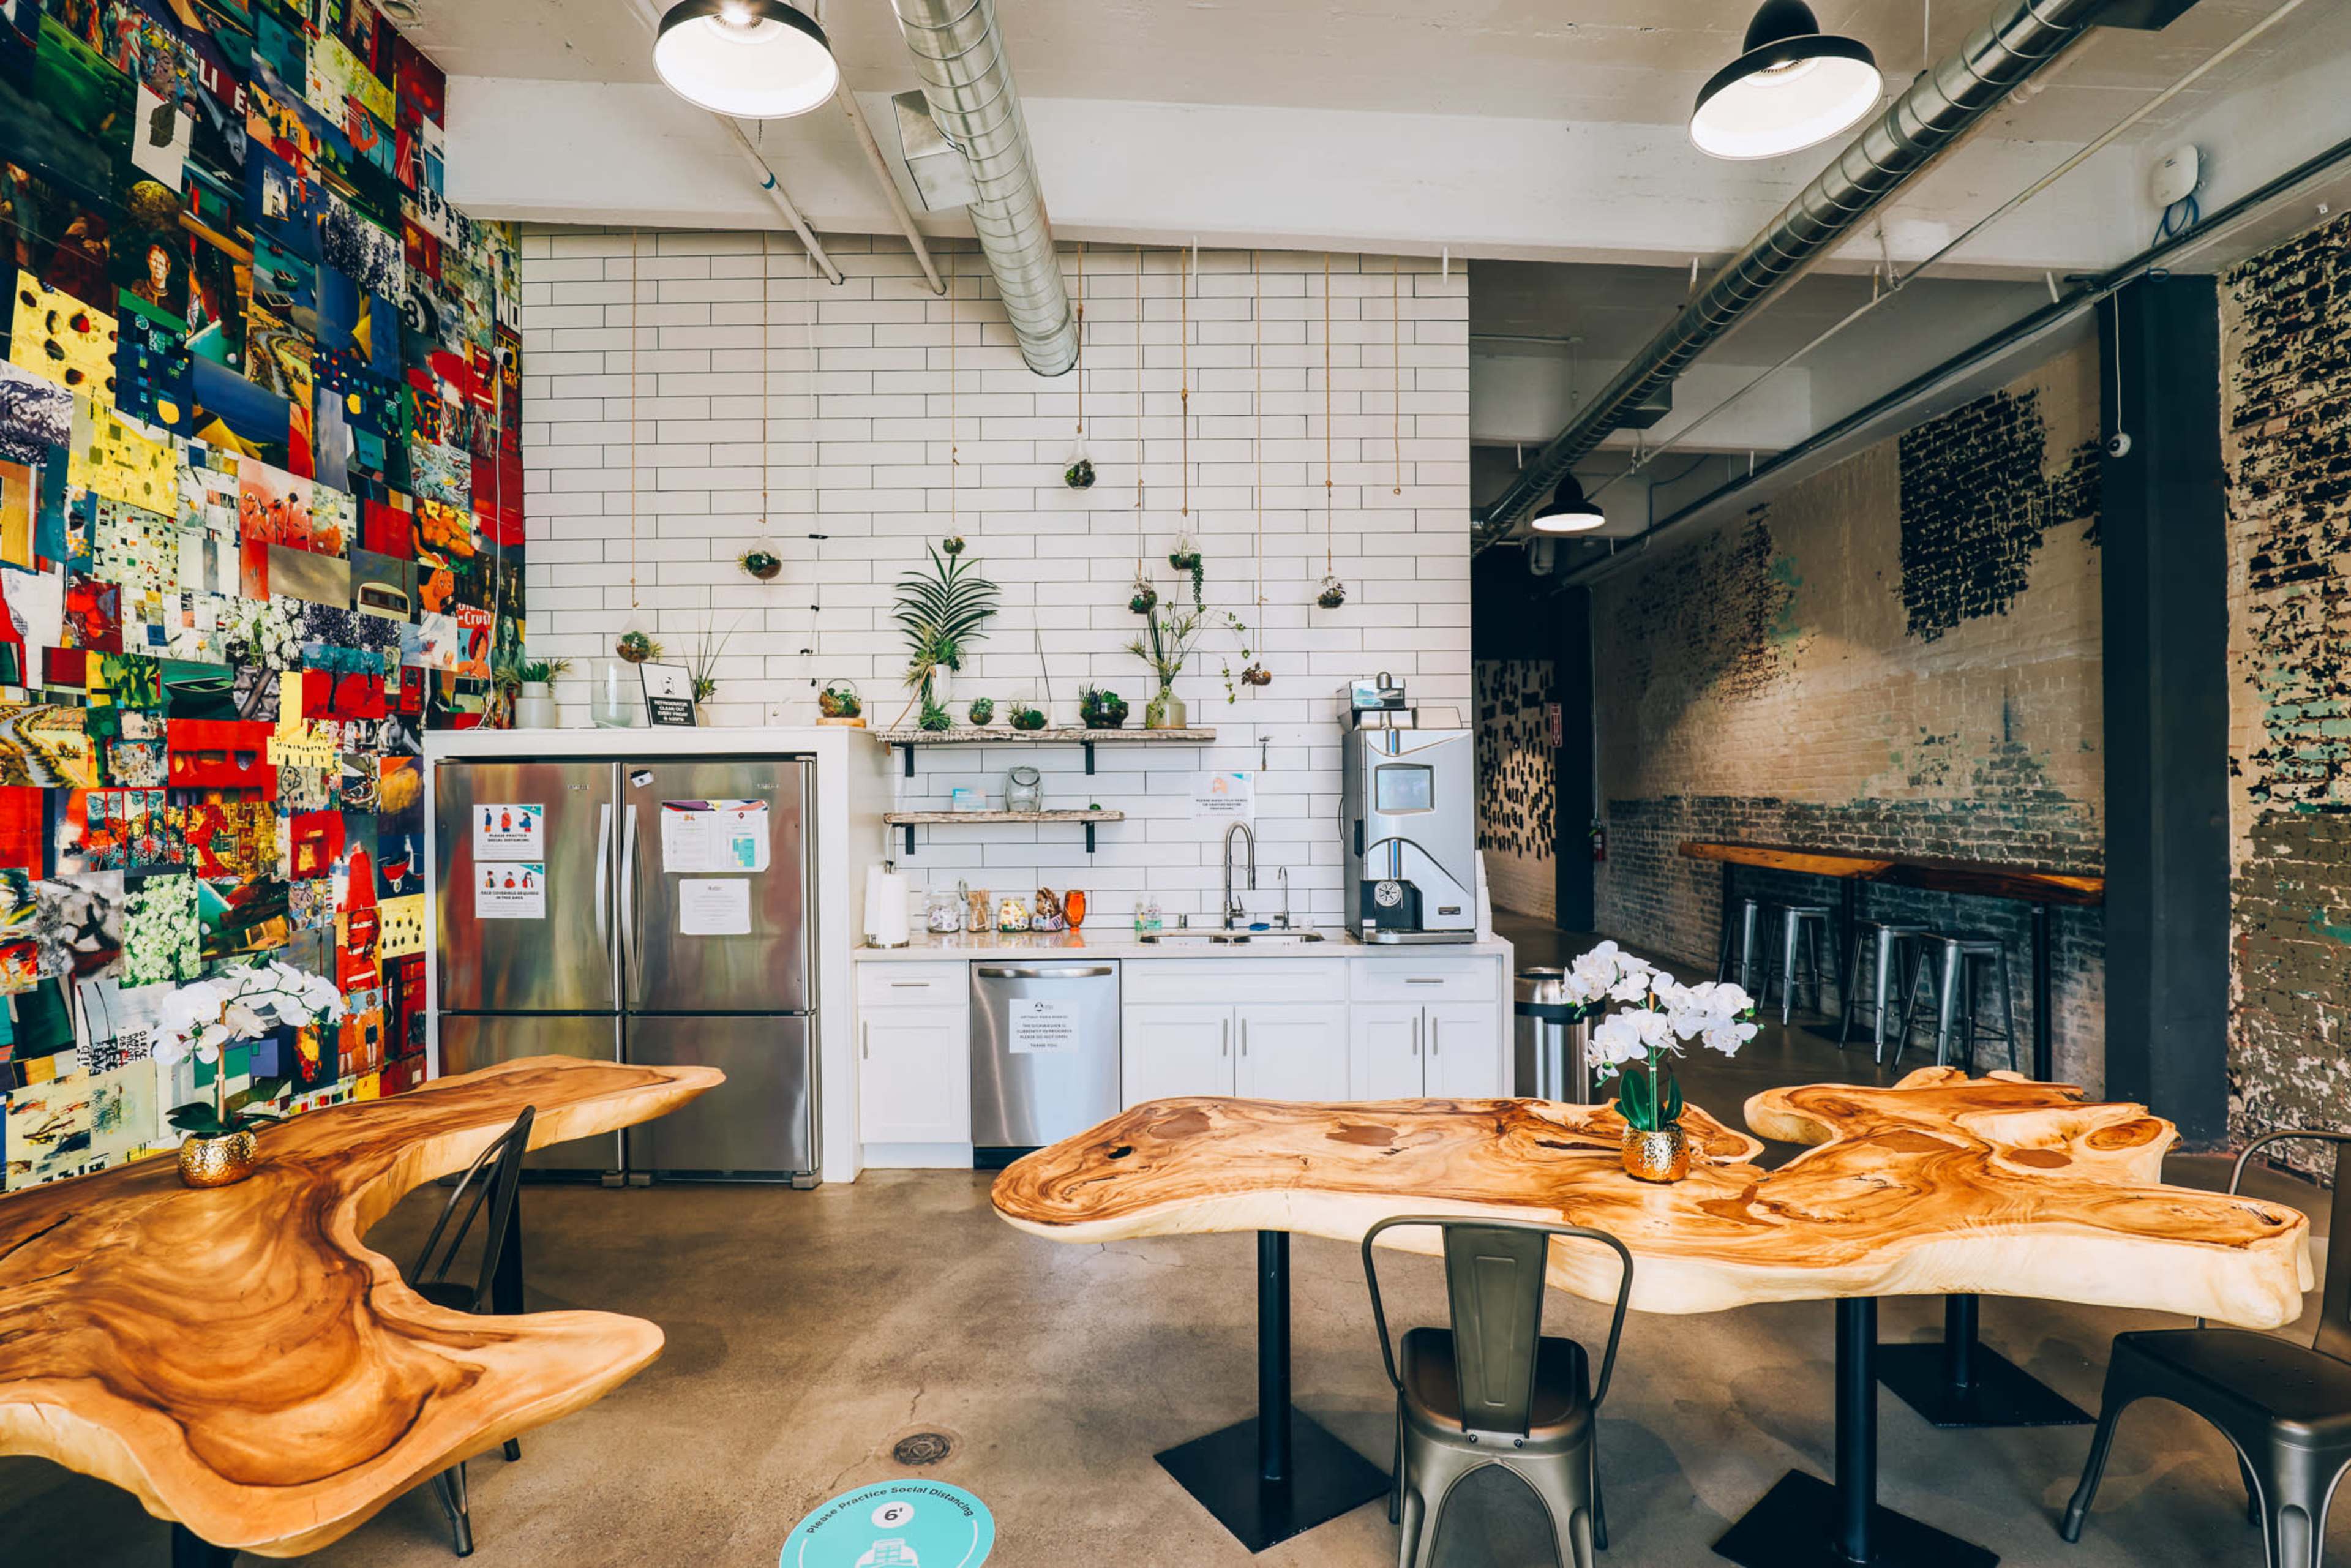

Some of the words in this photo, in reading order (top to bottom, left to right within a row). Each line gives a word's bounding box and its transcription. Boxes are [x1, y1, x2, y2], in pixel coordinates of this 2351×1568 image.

[806, 1509, 838, 1534] Please
[838, 1490, 887, 1509] Practice
[929, 1488, 973, 1517] Distancing
[884, 1507, 903, 1521] 6'
